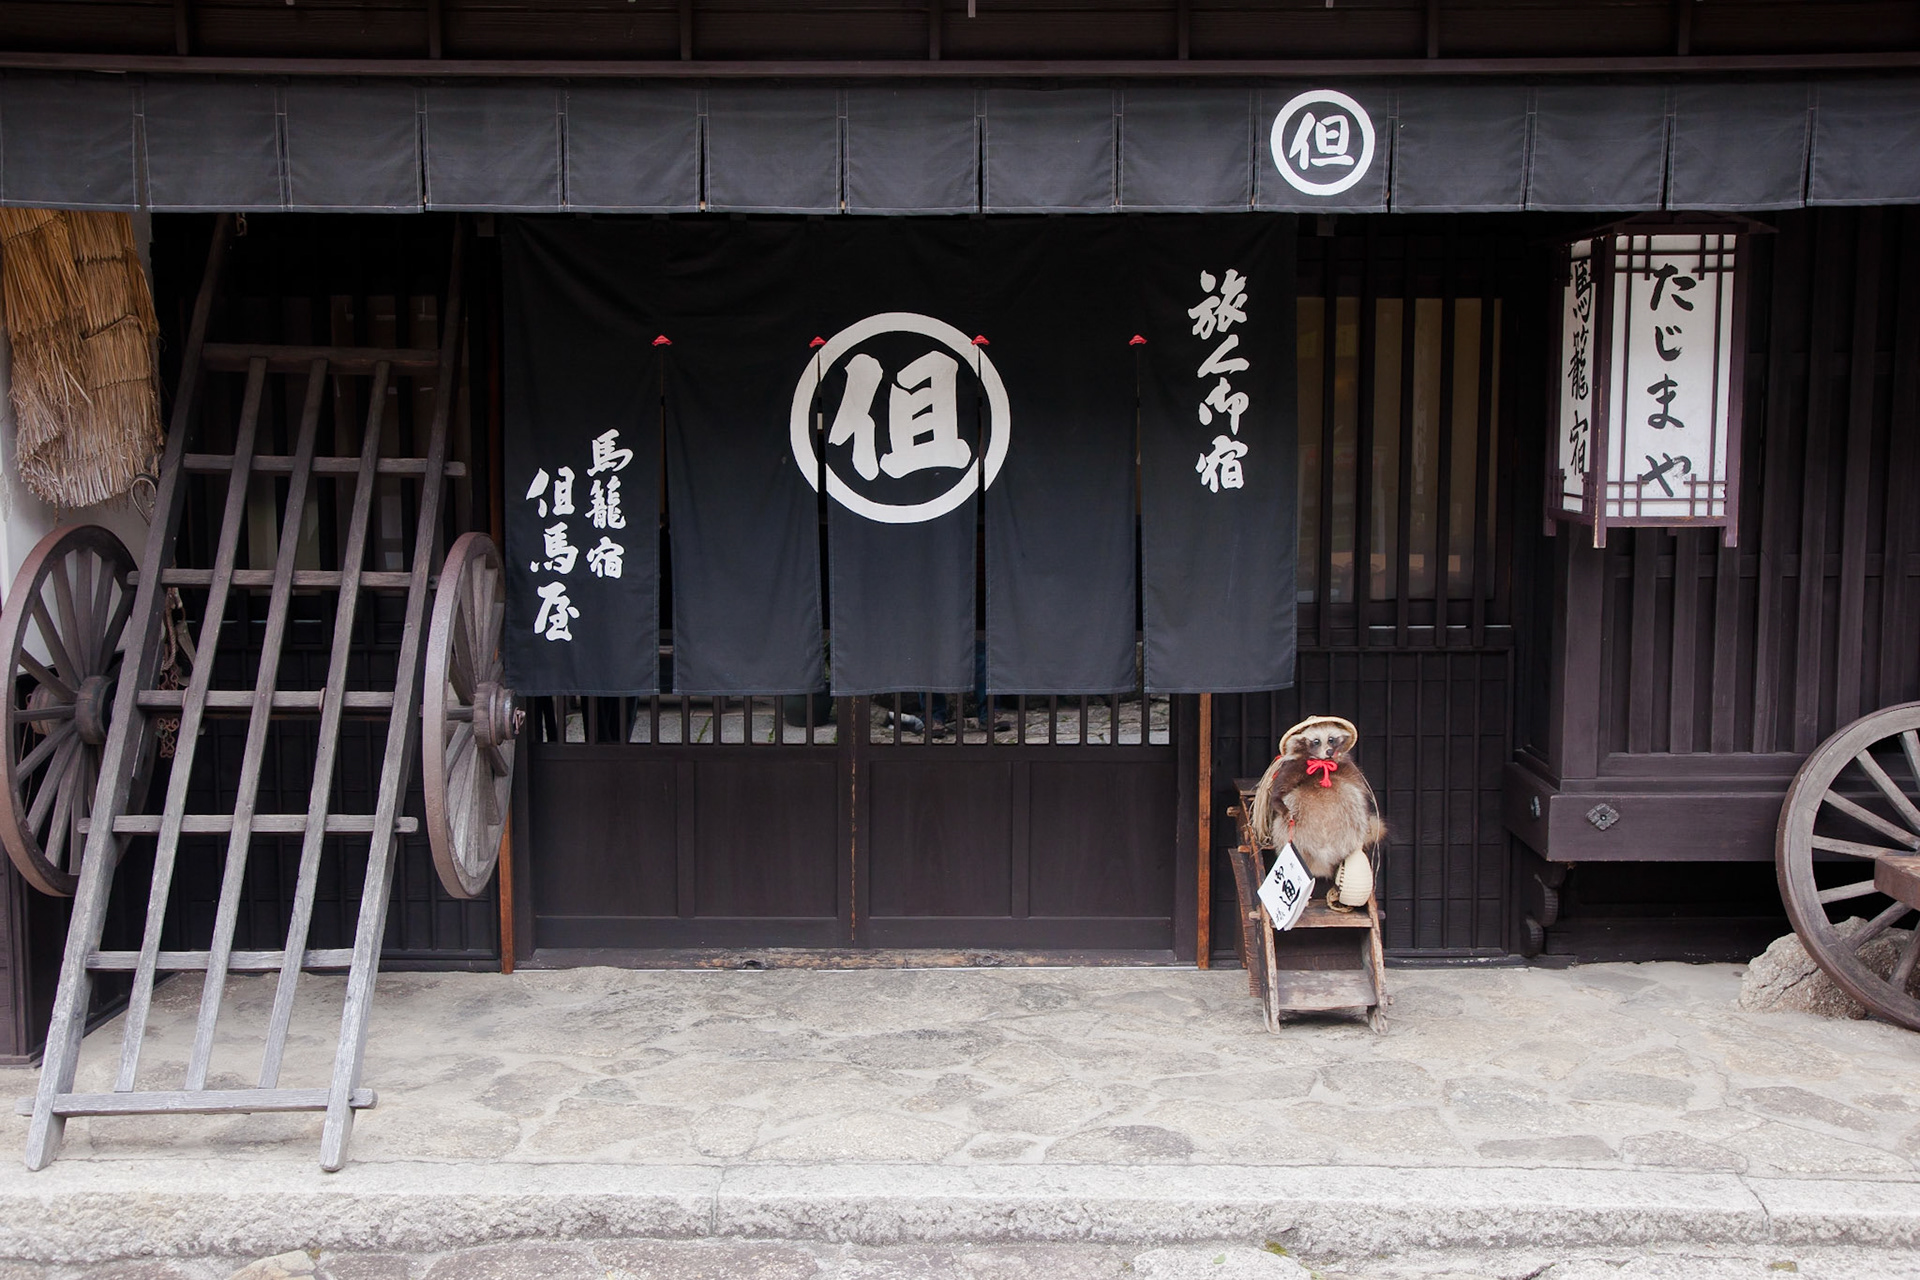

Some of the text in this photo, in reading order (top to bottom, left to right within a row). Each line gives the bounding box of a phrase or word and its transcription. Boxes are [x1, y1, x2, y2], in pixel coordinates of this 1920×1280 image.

[1288, 111, 1356, 171] 但
[1187, 268, 1250, 494] 旅人御宿
[1641, 262, 1698, 498] たじまや
[525, 465, 581, 643] 但馬屋
[585, 428, 634, 580] 馬籠宿
